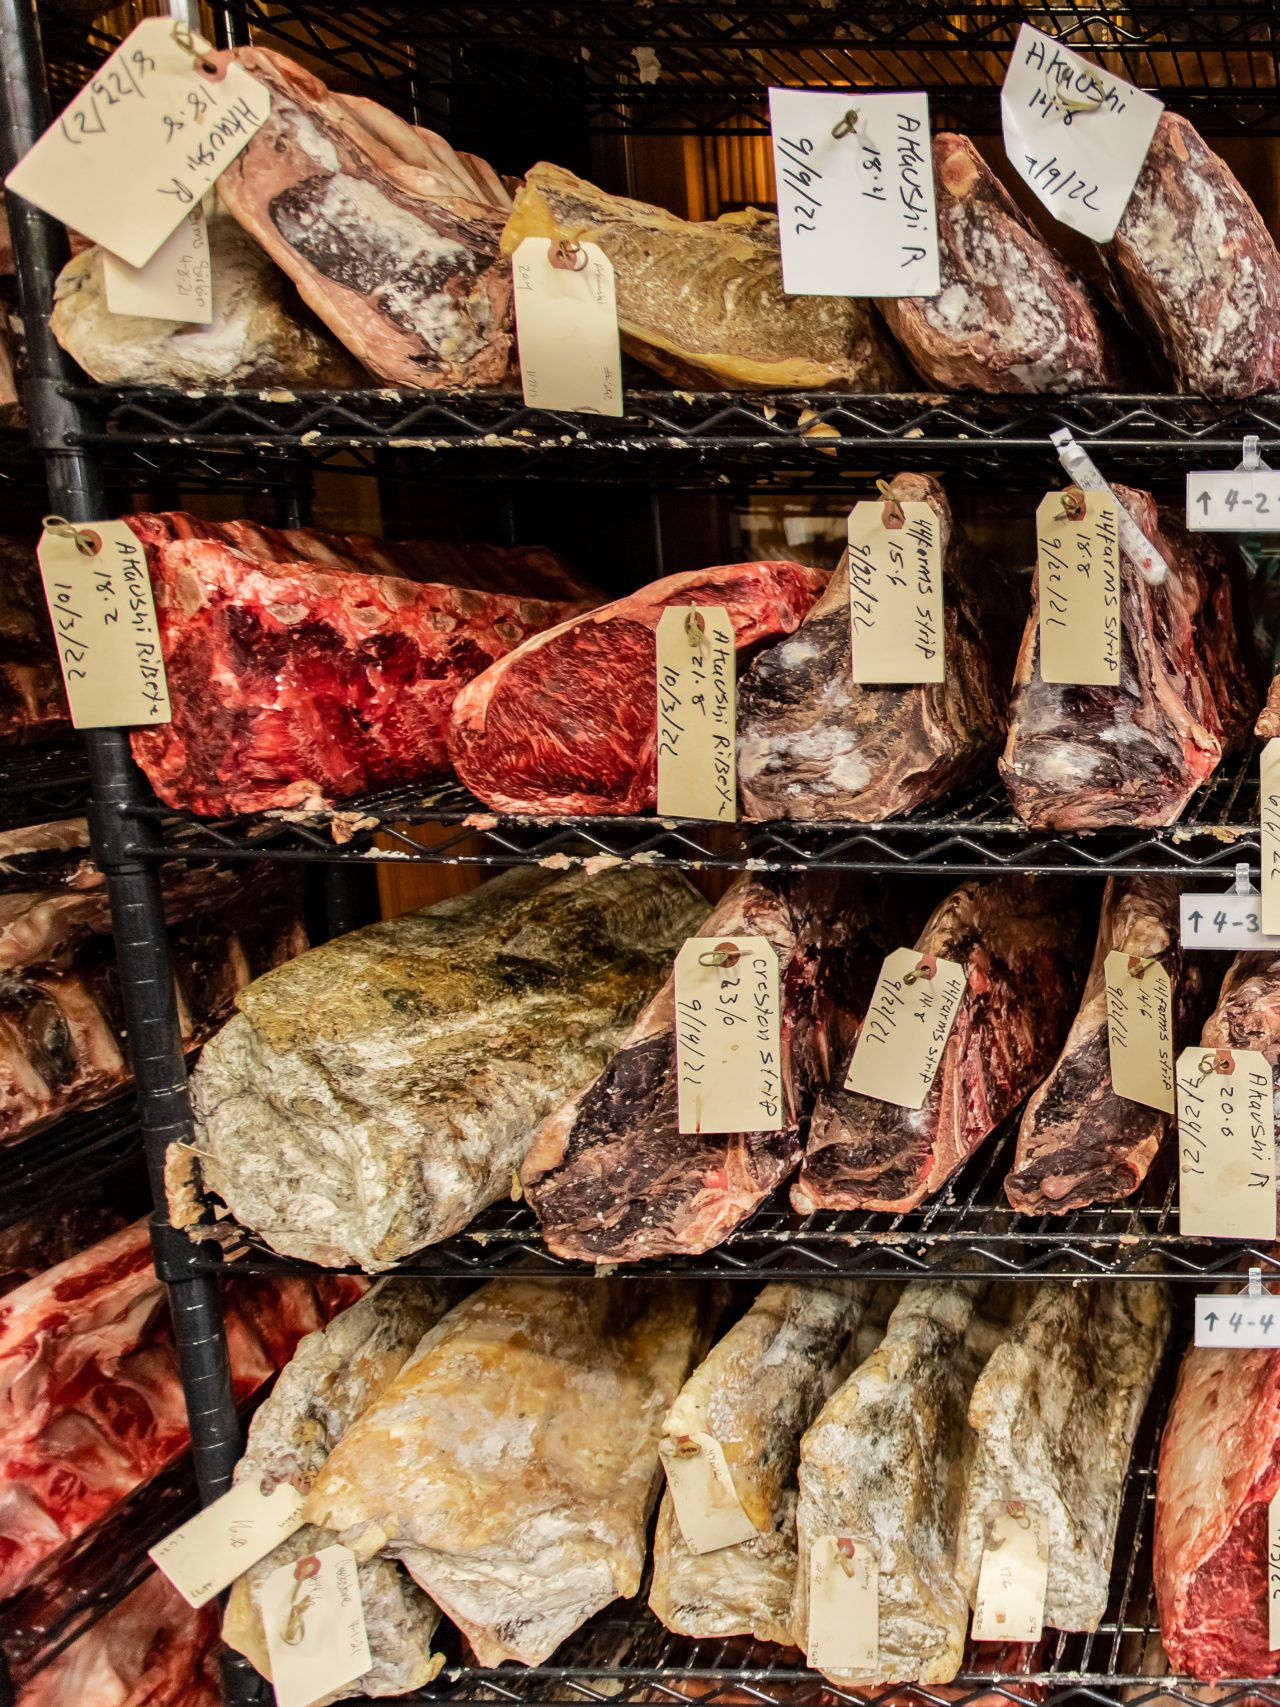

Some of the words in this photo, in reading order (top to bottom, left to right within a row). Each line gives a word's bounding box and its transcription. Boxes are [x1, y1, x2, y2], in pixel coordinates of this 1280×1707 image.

[777, 137, 822, 234] 9/9/22
[862, 146, 886, 200] 18.4
[1025, 154, 1101, 211] 9/9/22
[901, 247, 926, 267] R
[1224, 487, 1270, 515] 4-2
[1077, 534, 1092, 578] 18.8
[94, 572, 118, 625] 18.2
[54, 584, 89, 680] 10/3/22
[657, 666, 684, 756] 10/3/22
[1212, 909, 1260, 934] 4-3
[1248, 1173, 1269, 1187] R
[1228, 1310, 1275, 1334] 4-4
